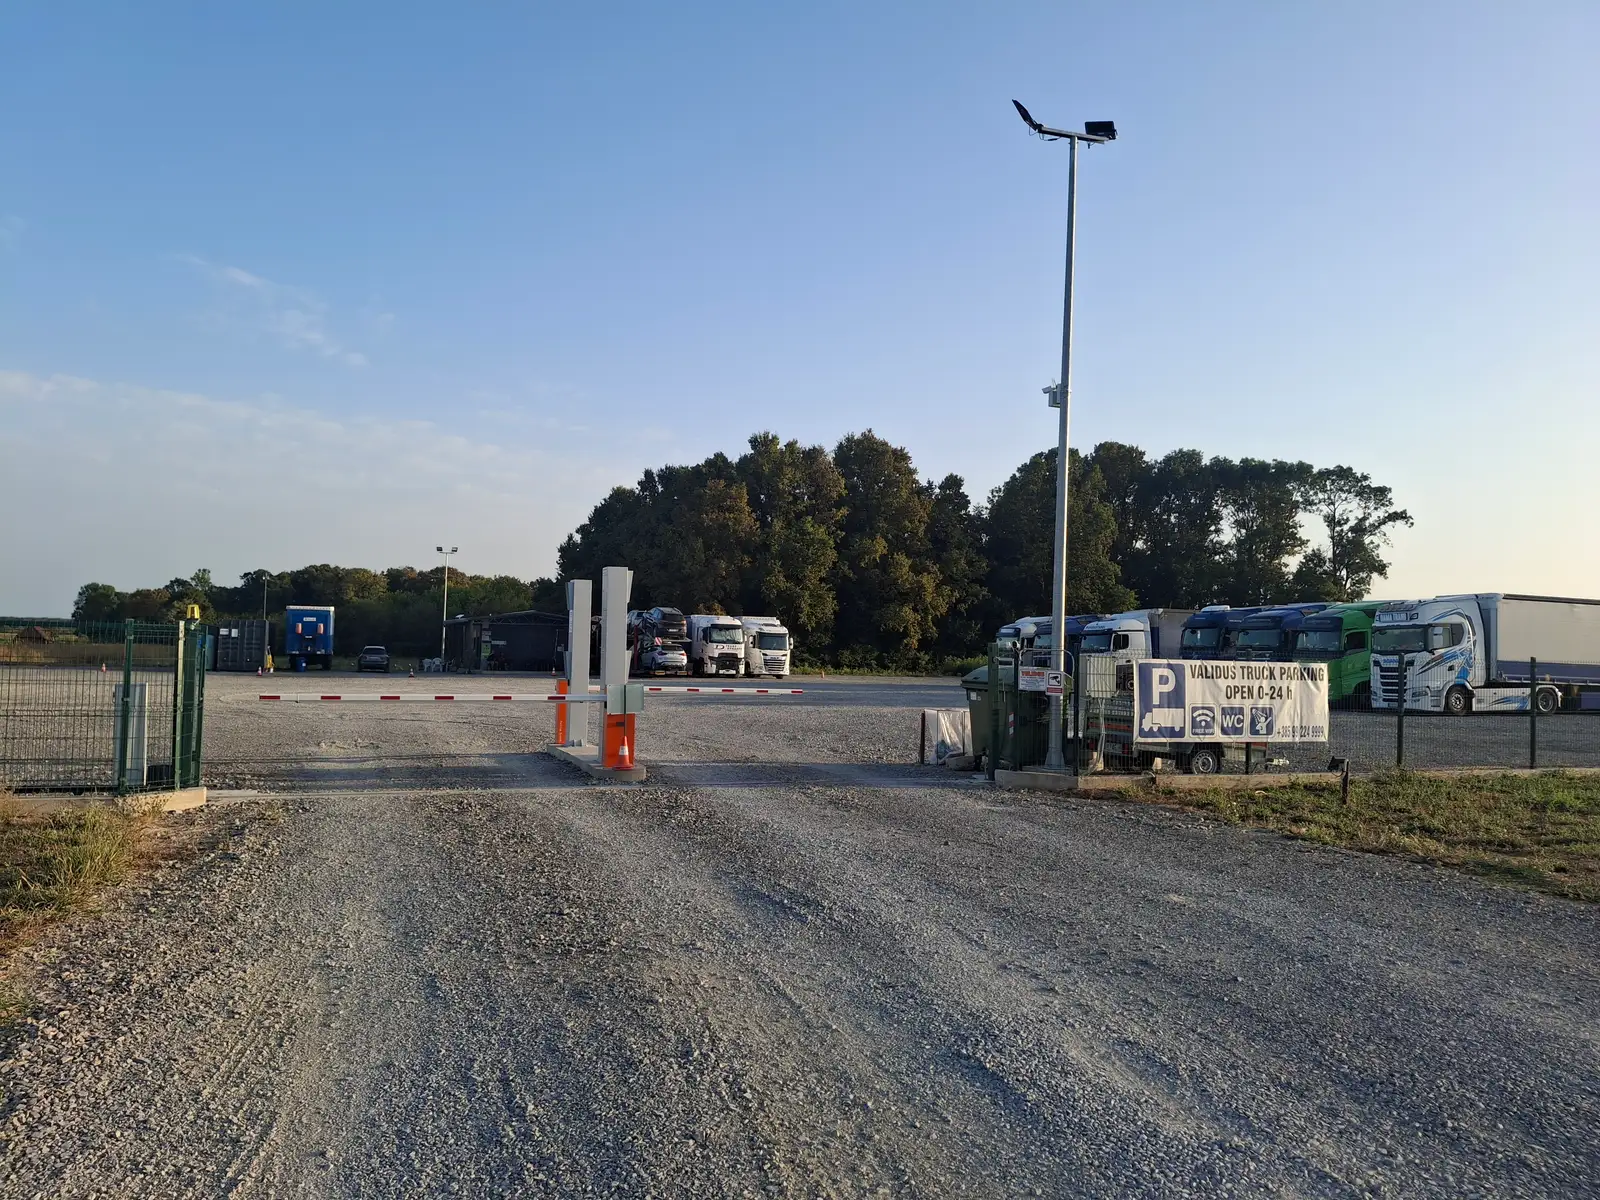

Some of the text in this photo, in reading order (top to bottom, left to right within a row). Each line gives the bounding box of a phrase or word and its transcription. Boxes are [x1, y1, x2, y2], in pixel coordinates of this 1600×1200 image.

[1190, 664, 1325, 682] VALIDUS TRUCK PARKING
[1152, 668, 1176, 705] P
[1225, 684, 1293, 700] OPEN 0-24 h
[1222, 714, 1244, 728] WC
[1300, 725, 1310, 738] 224
